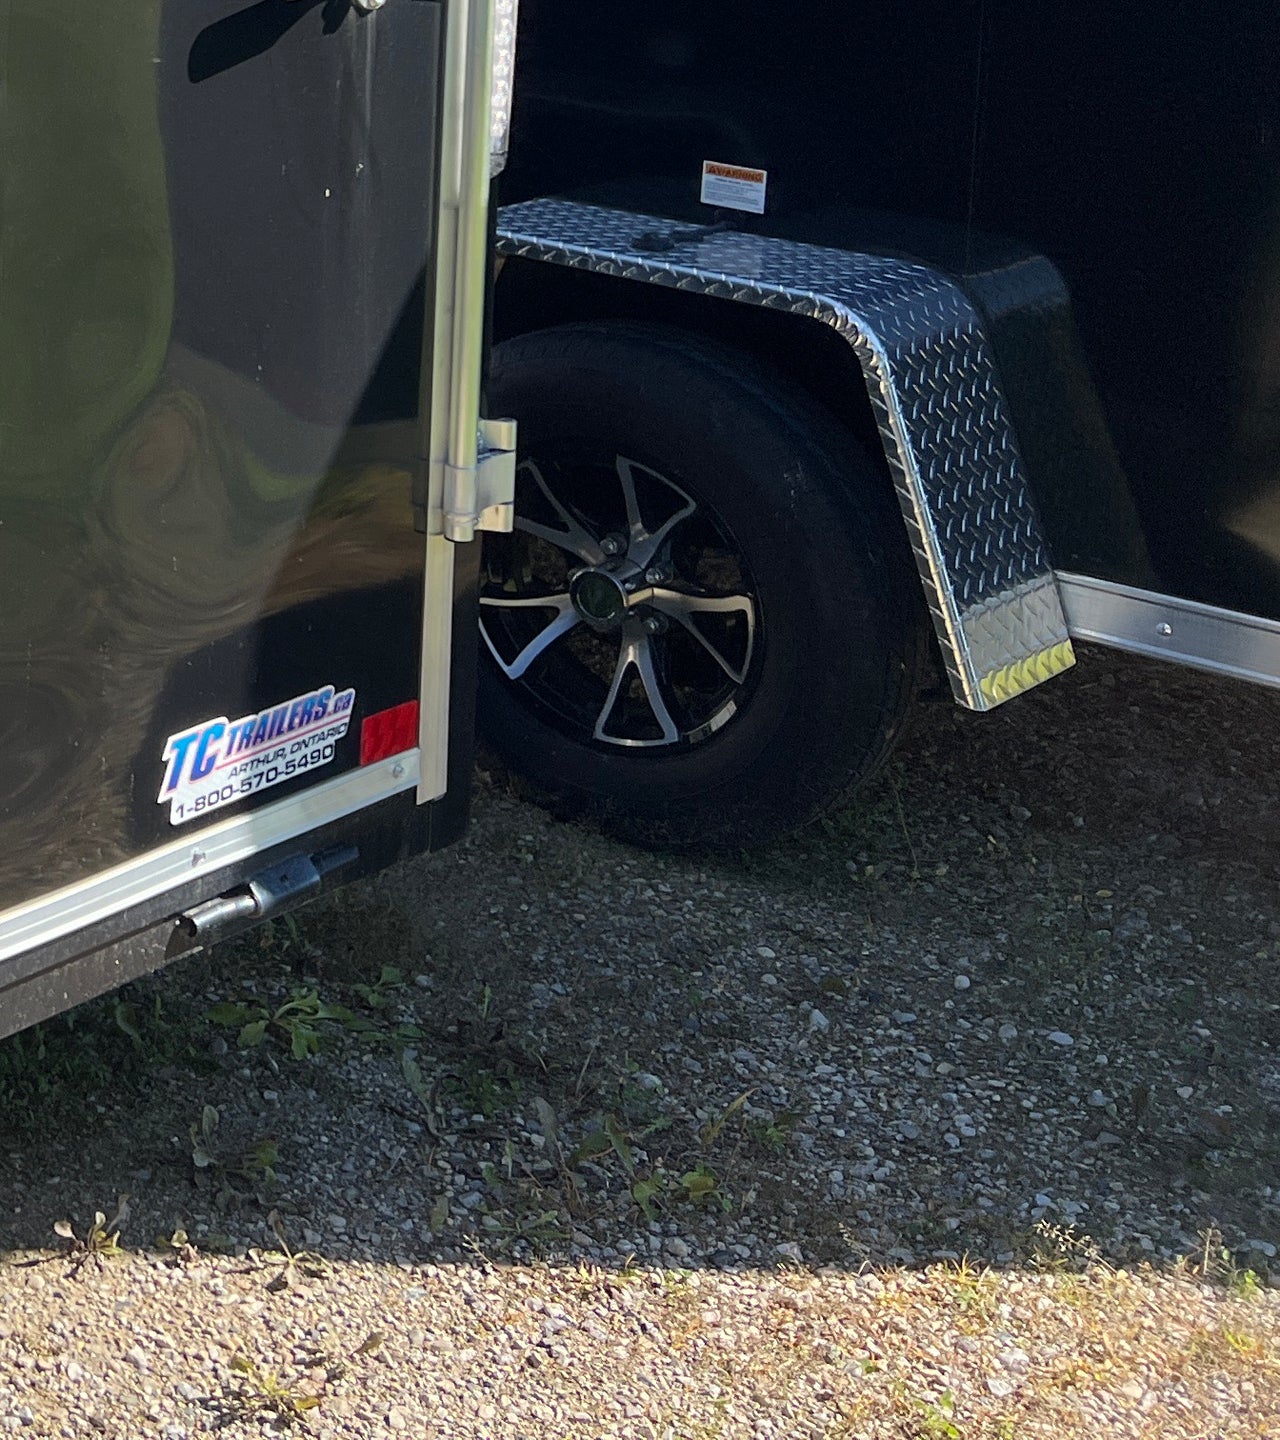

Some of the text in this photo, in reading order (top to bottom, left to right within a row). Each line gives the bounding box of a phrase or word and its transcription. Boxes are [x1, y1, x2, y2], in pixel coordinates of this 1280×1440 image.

[166, 722, 227, 793] TC
[290, 721, 348, 755] ONTARIO
[175, 745, 334, 820] 1-800-570-5490
